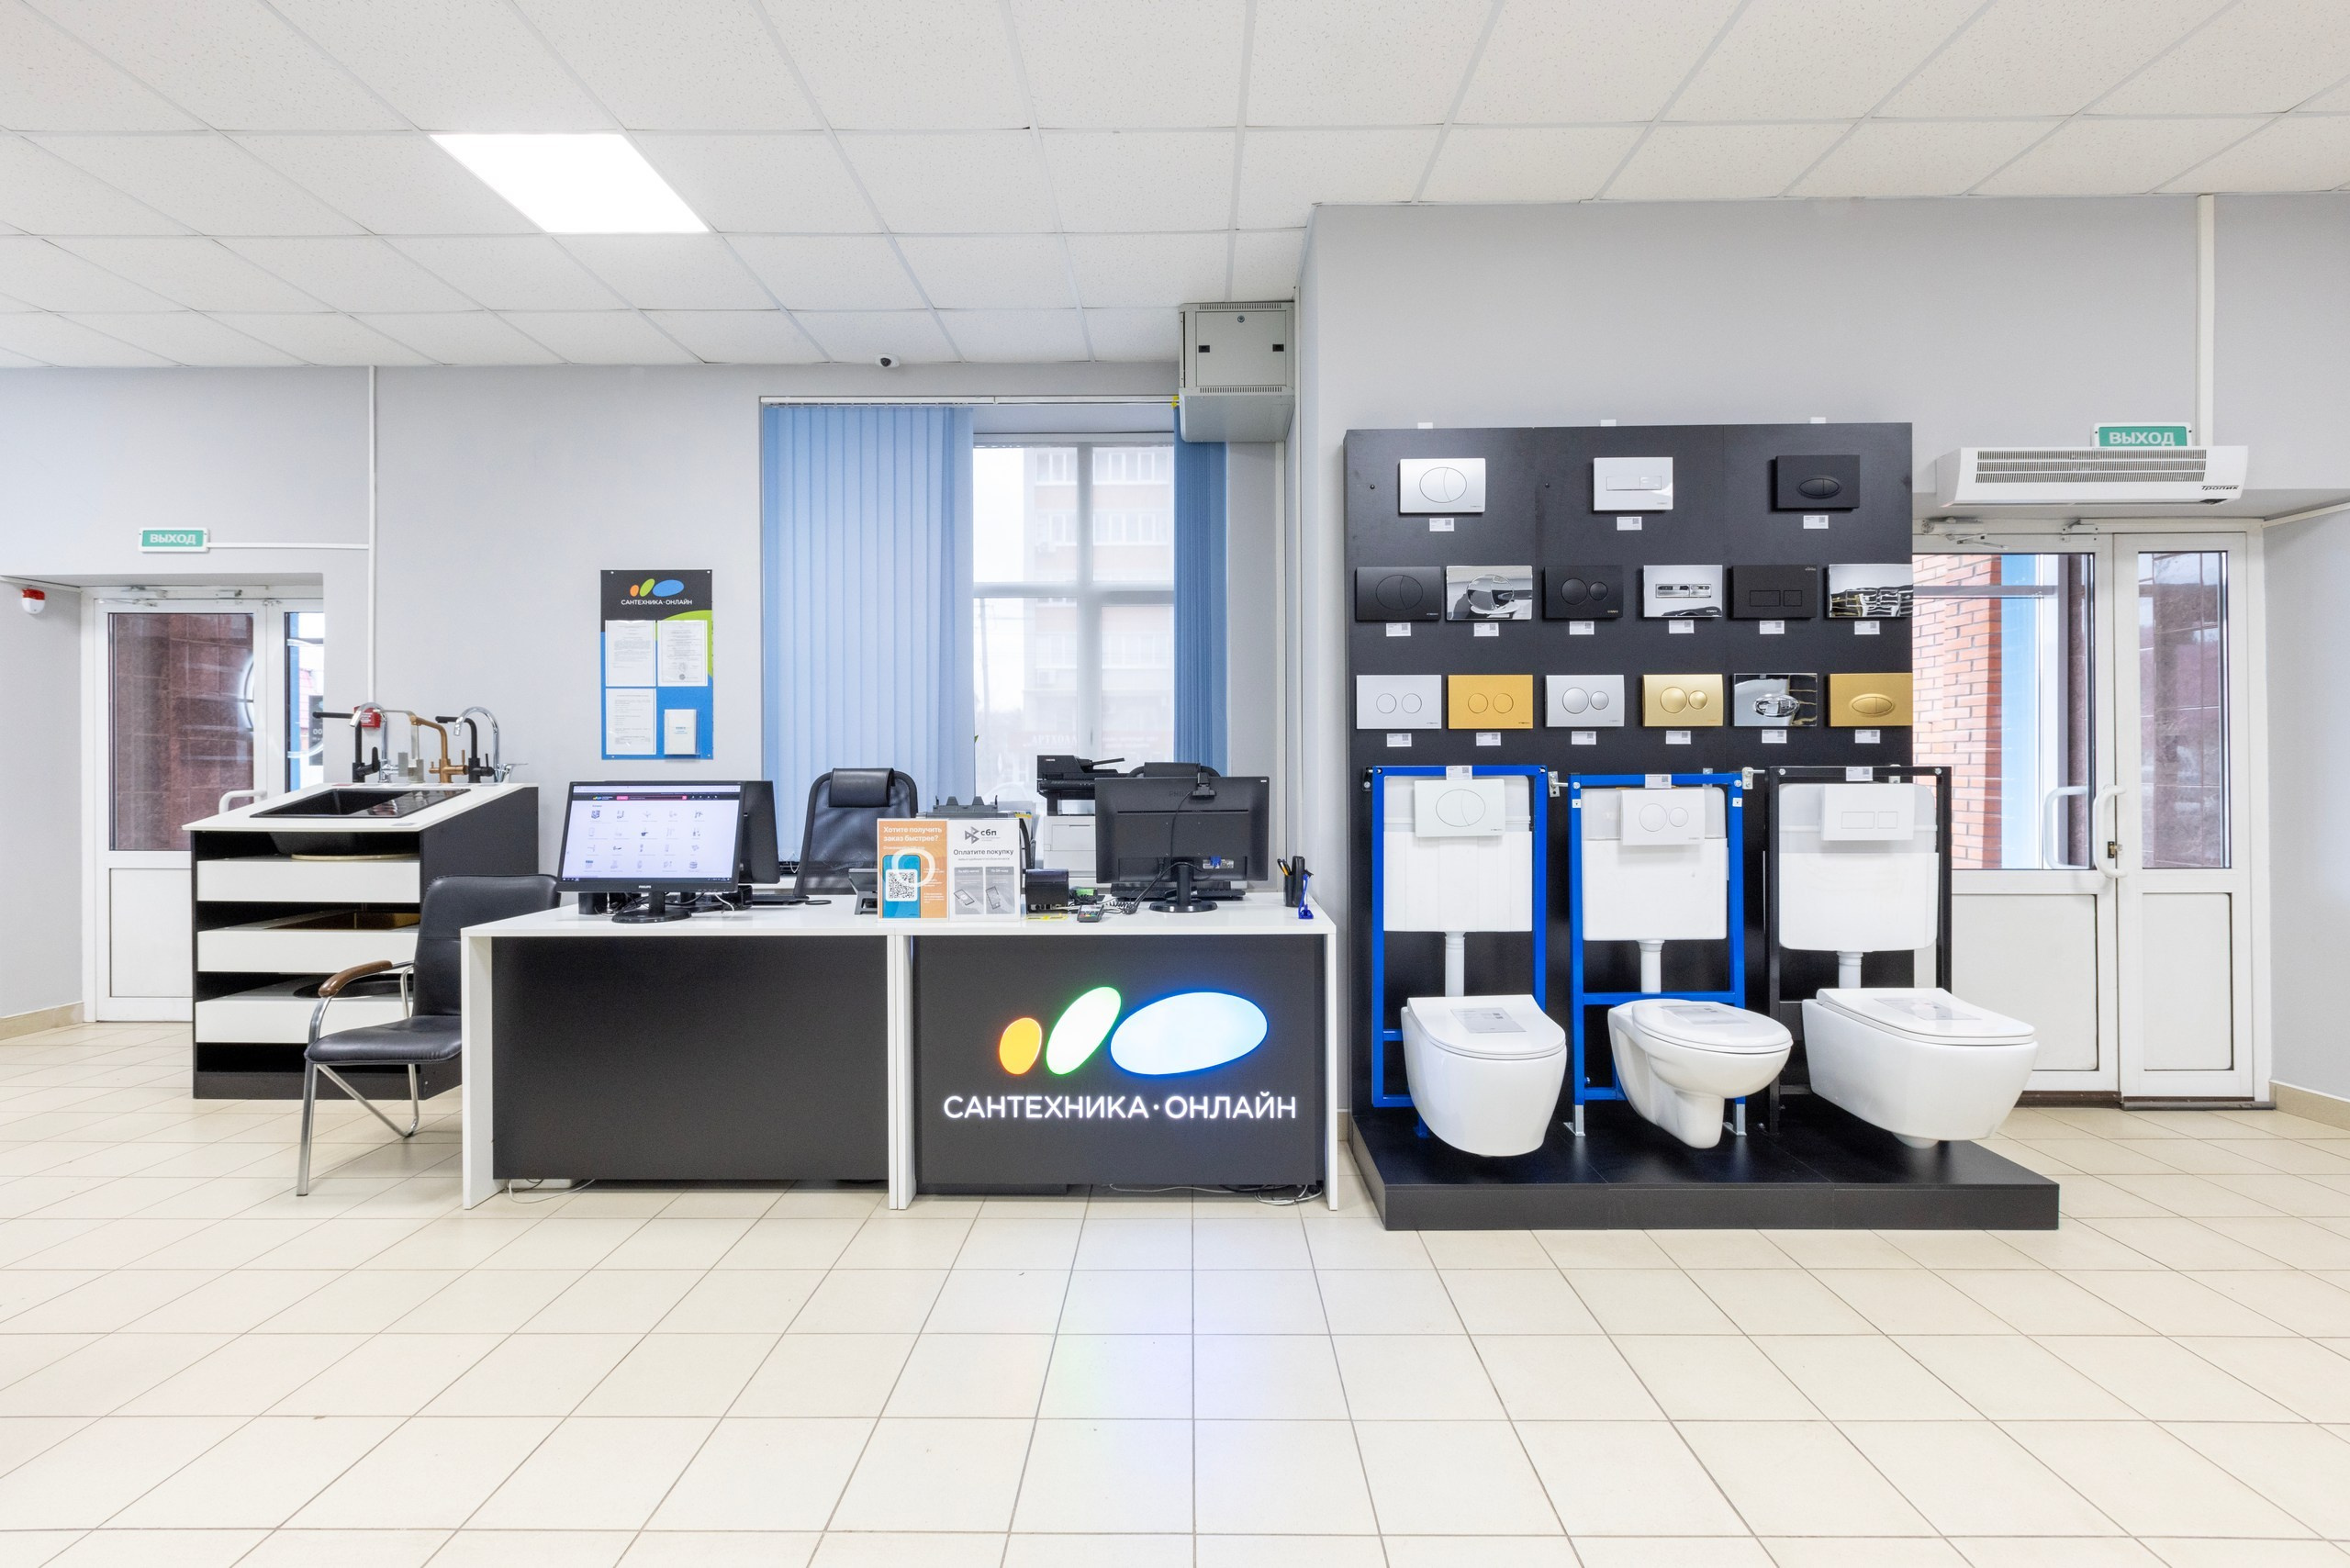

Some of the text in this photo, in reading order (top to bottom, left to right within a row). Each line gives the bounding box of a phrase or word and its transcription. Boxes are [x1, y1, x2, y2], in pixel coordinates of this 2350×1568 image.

[2109, 431, 2176, 446] ВЫХОД
[150, 533, 196, 545] ВЫХОД
[883, 825, 908, 834] Хотите
[904, 834, 939, 843] быстрее?
[986, 848, 1014, 857] покупку
